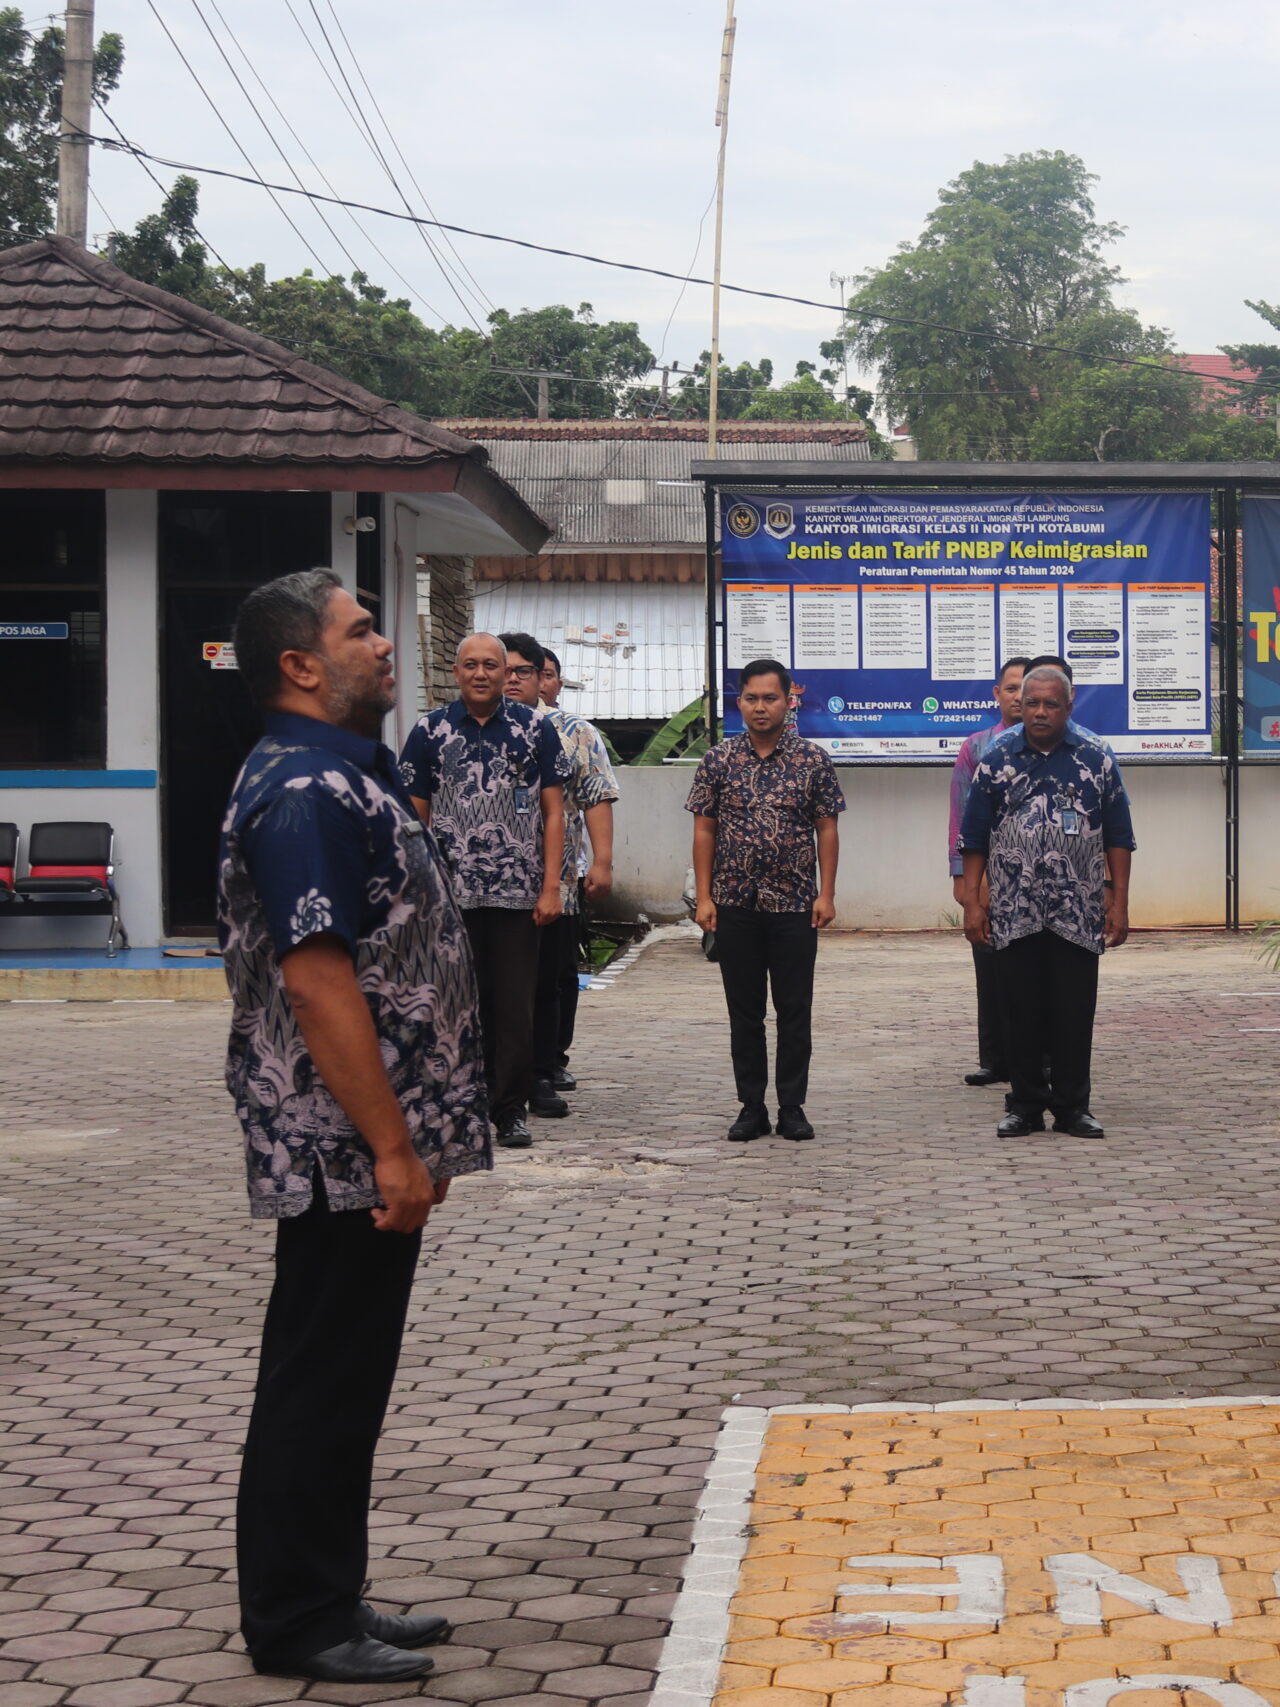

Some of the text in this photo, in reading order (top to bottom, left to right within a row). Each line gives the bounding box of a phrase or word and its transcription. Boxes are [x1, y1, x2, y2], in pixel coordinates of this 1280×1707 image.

[930, 505, 1011, 513] PEMASYARAKATAN
[1013, 505, 1056, 513] REPUBLIK
[1058, 505, 1105, 513] INDONESIA
[805, 515, 842, 523] KANTOR
[844, 515, 881, 523] WILAYAH
[883, 515, 937, 523] DIREKTORAT
[939, 515, 985, 523] JENDERAL
[804, 524, 1105, 534] KANTOR IMIGRASI KELAS II NON TPI KOTABUMI
[786, 540, 1148, 563] Jenis dan Tarif PNBP Keimigrasian
[859, 566, 1075, 576] Peraturan Pemerintah Nomor 45 Tahun 2024
[0, 626, 47, 635] POS JAGA
[847, 702, 912, 710] TELEPON/FAX
[838, 714, 883, 722] 072421467
[933, 714, 982, 723] 072421467
